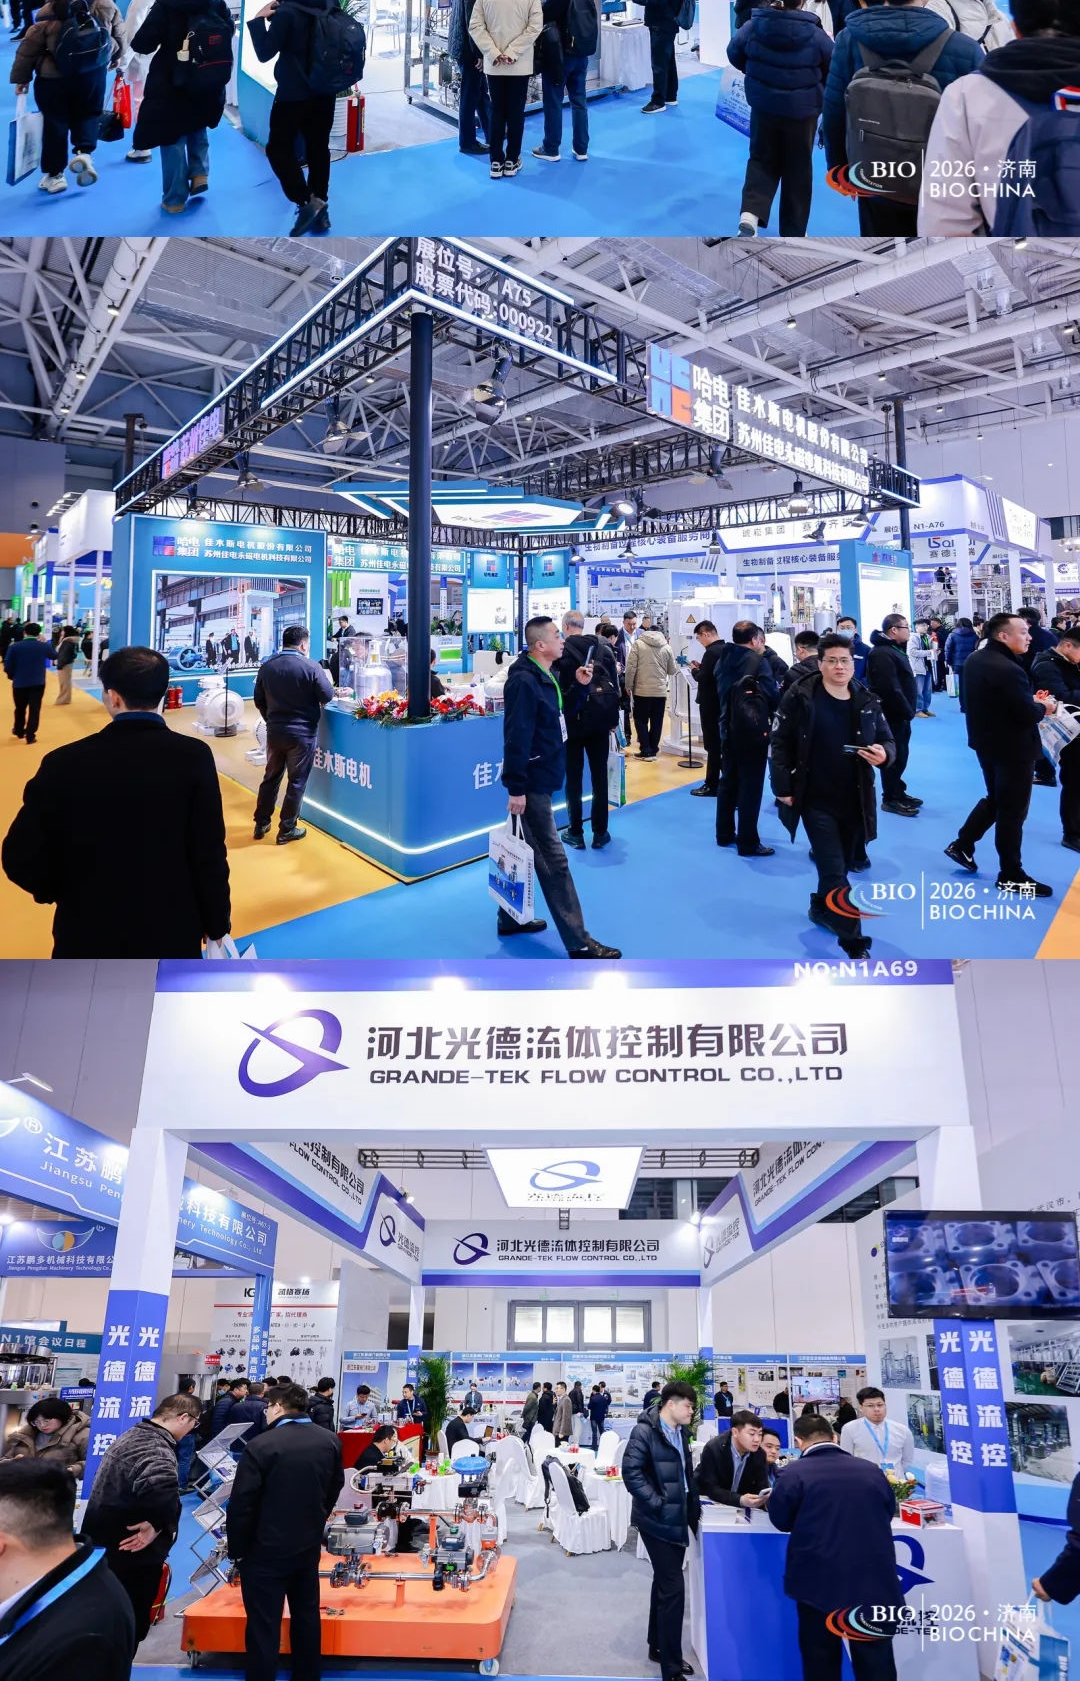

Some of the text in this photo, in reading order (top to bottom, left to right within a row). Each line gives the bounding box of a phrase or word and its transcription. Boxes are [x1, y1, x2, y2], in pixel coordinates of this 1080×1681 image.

[502, 277, 532, 308] A75
[692, 365, 731, 407] 哈电
[692, 398, 730, 442] 集团
[735, 385, 869, 468] 佳木斯电机股份有限公司
[736, 421, 870, 496] 苏州佳电永磁电机科技有限公司
[913, 521, 945, 531] N1-A76
[204, 538, 313, 553] 佳木斯电机股份有限公司
[204, 549, 313, 564] 苏州佳电永磁电机科技有限公司
[793, 960, 918, 979] NO:N1A69
[366, 1022, 849, 1061] 河北光德流体控制有限公司
[541, 1068, 606, 1085] FLOW
[616, 1067, 730, 1084] CONTROL
[740, 1066, 843, 1084] CO.,LTD
[43, 1132, 124, 1185] 江苏鹏
[311, 1157, 340, 1188] CONTROL
[39, 1161, 93, 1189] Jiangsu
[200, 1224, 238, 1247] Technology
[496, 1238, 660, 1253] 河北光德流体控制有限公司
[556, 1254, 579, 1262] FLOW
[581, 1254, 620, 1262] CONTROL
[129, 1326, 160, 1418] 光德流
[939, 1330, 974, 1466] 光德流控
[969, 1330, 1008, 1467] 光德流控
